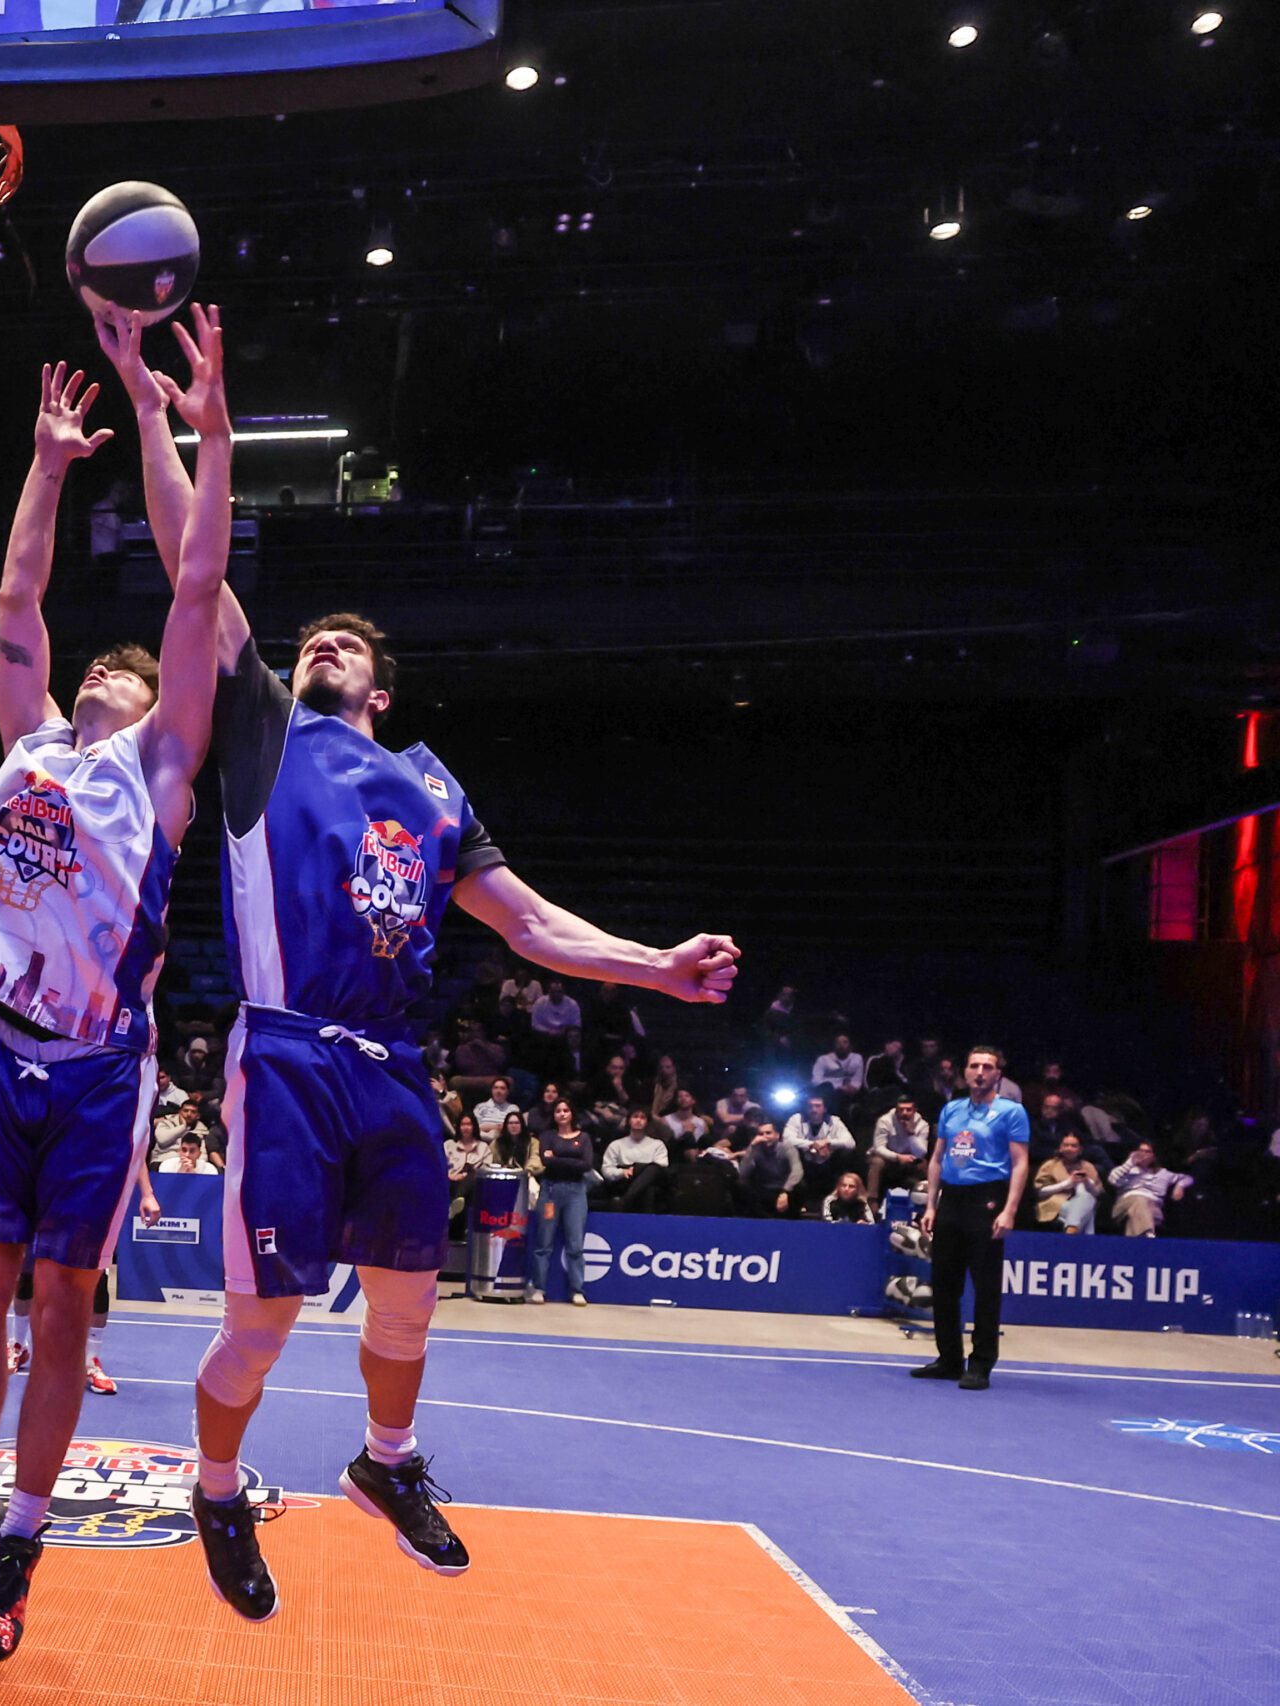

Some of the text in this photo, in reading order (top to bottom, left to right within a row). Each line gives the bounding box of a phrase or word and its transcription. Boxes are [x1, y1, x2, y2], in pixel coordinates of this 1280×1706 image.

[3, 794, 72, 826] ed Bull
[386, 852, 424, 882] Bull
[619, 1243, 781, 1283] Castrol
[1001, 1259, 1134, 1301] NEAKS
[108, 1457, 196, 1476] Bul
